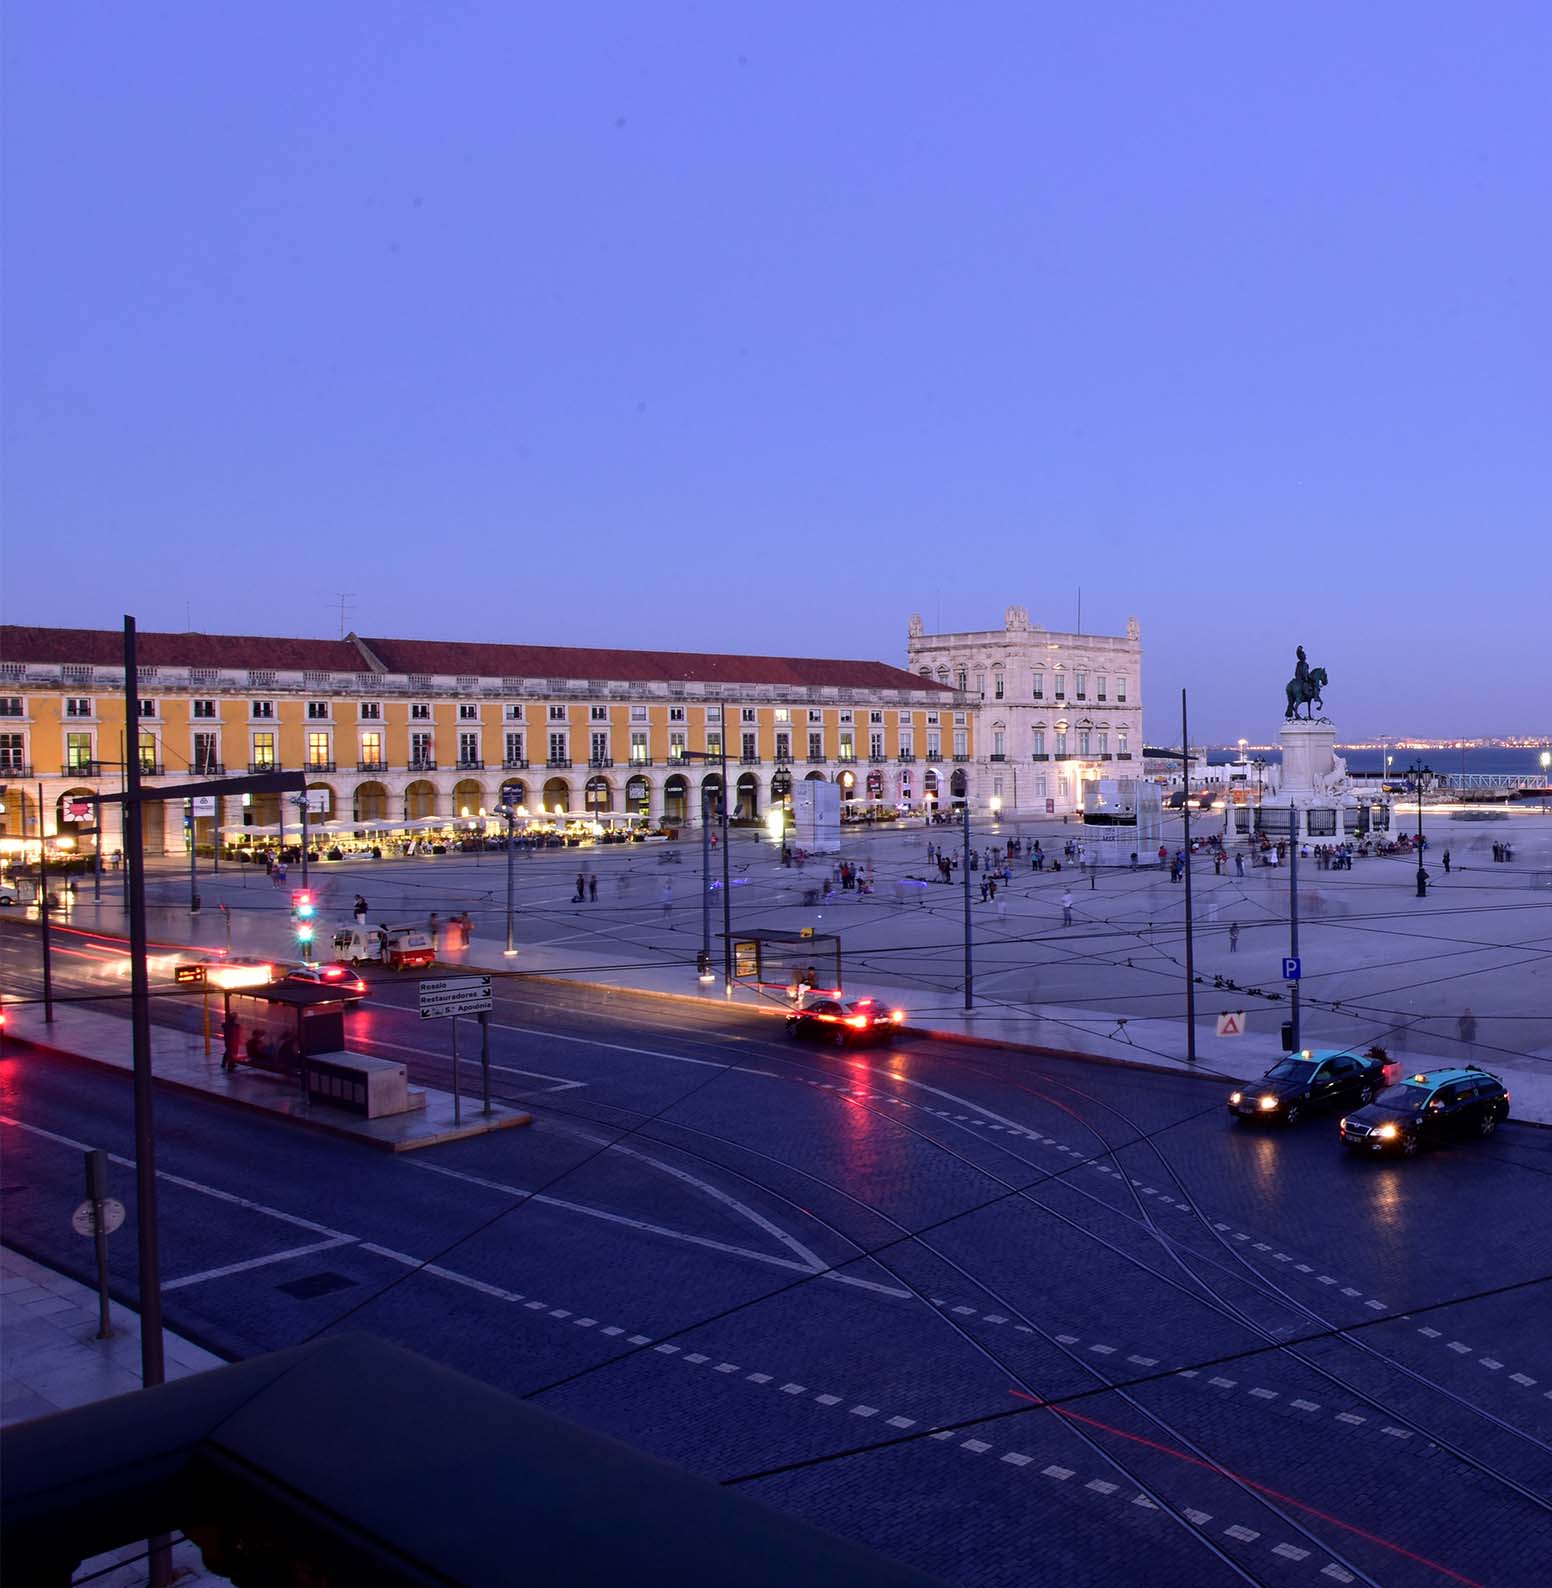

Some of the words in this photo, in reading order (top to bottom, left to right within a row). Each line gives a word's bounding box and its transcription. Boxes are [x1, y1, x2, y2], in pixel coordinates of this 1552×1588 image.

[1286, 959, 1297, 978] P
[420, 982, 447, 991] Rossio
[420, 992, 477, 1003] Restauradores
